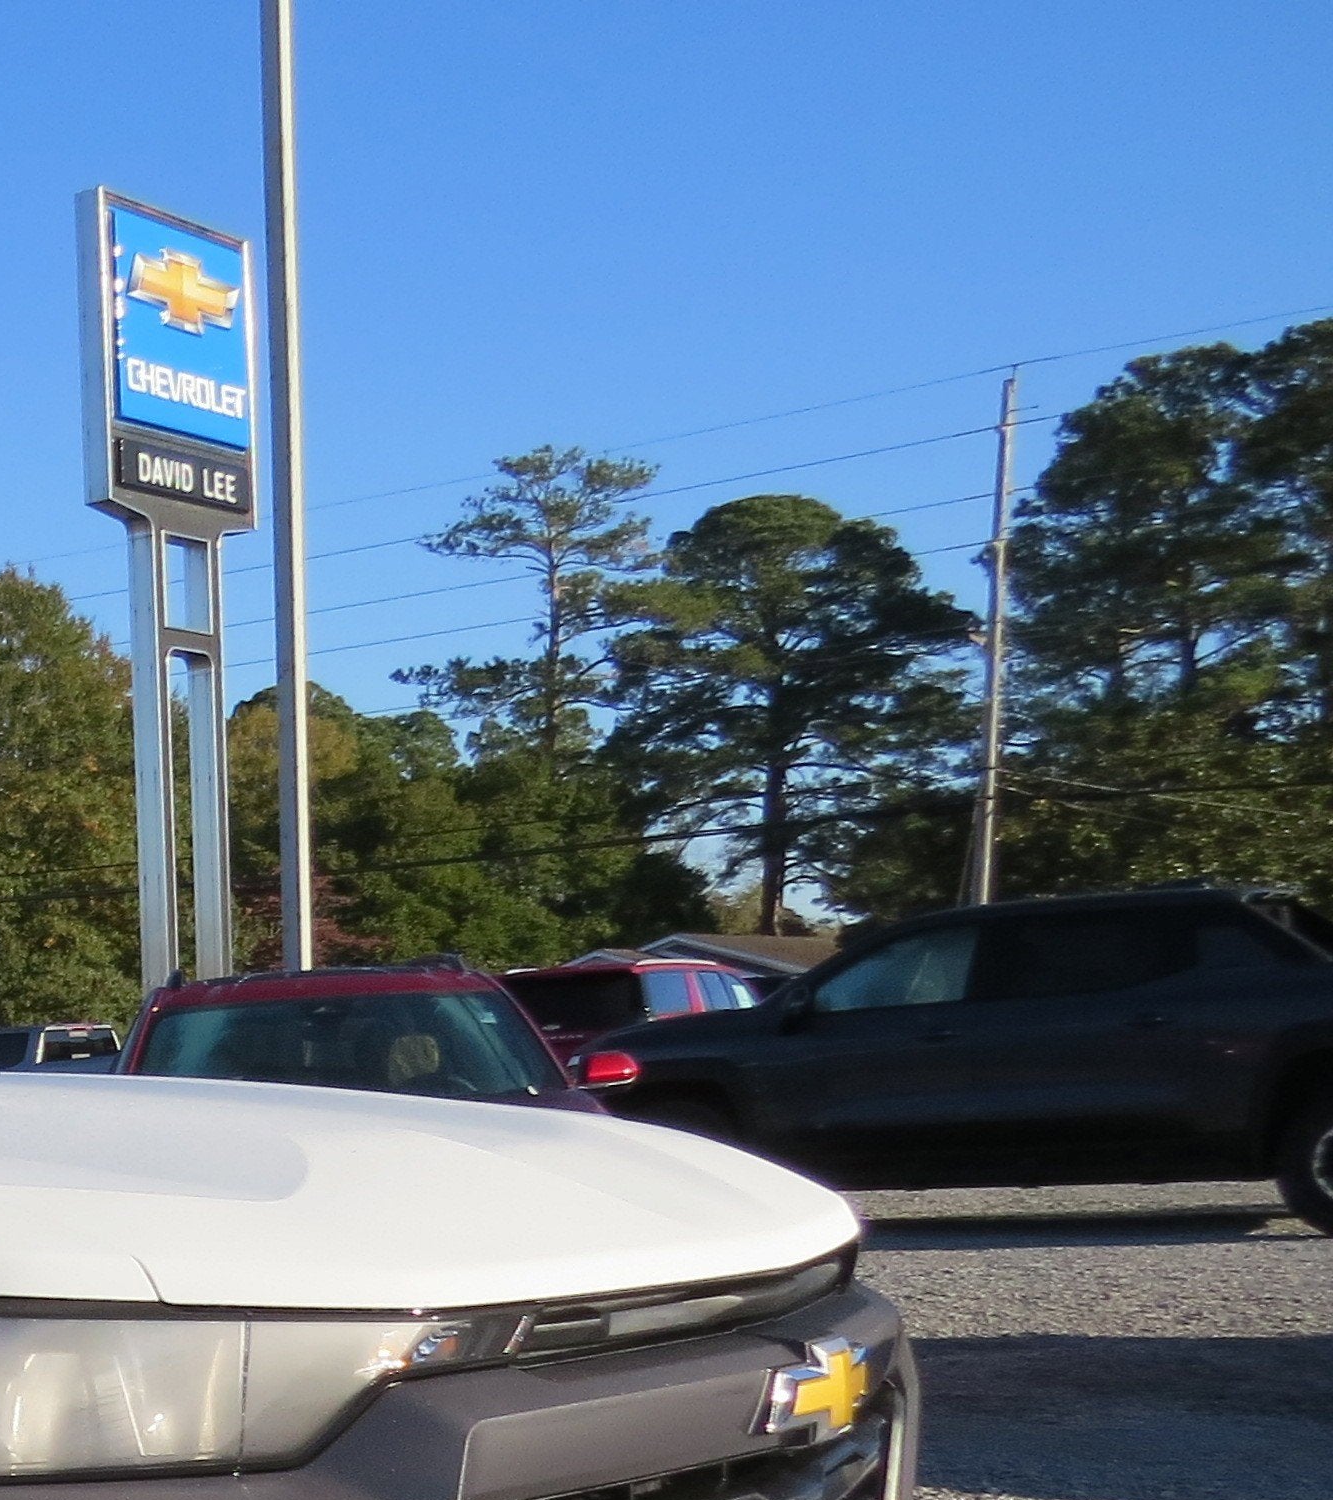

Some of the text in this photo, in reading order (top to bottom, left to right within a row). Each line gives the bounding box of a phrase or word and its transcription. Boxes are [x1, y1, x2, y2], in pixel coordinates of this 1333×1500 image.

[127, 357, 246, 419] CHEVROLET
[138, 452, 237, 505] DAVID LEE
